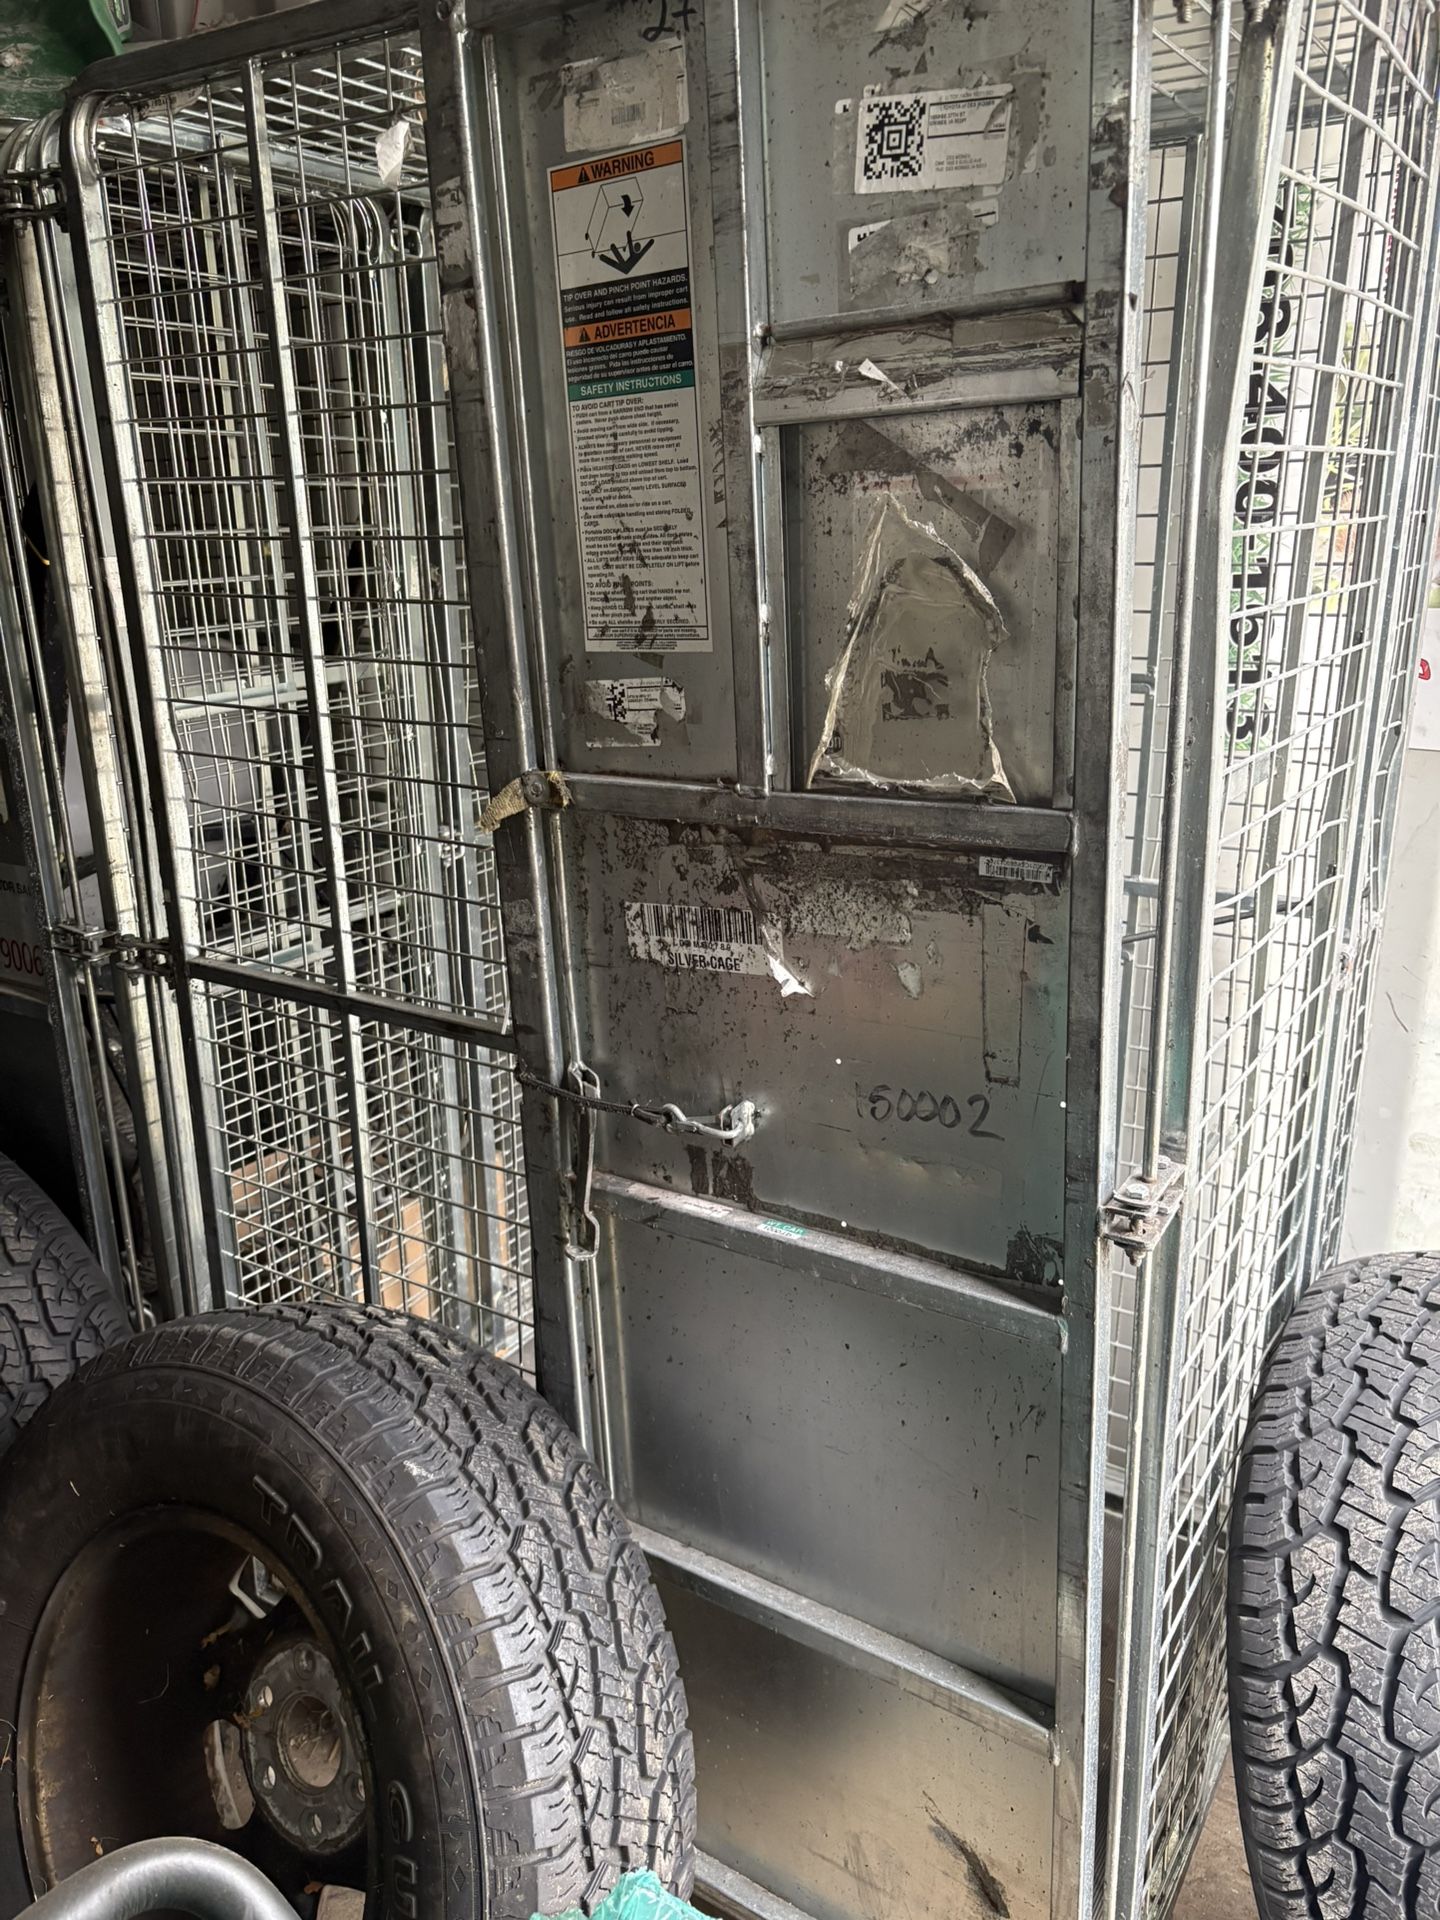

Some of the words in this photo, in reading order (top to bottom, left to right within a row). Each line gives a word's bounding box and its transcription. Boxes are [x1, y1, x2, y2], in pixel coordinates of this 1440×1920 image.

[590, 151, 655, 180] WARNING
[564, 294, 573, 302] TIP
[574, 291, 592, 300] OVER
[594, 288, 608, 297] AND
[609, 284, 629, 295] PINCH
[631, 280, 651, 291] POINT
[652, 274, 687, 287] HAZARDS.
[594, 314, 675, 340] ADVERTENCIA
[580, 382, 614, 396] SAFETY
[616, 374, 681, 392] INSTRUCTIONS
[581, 403, 598, 411] AVOID
[599, 401, 615, 409] CART
